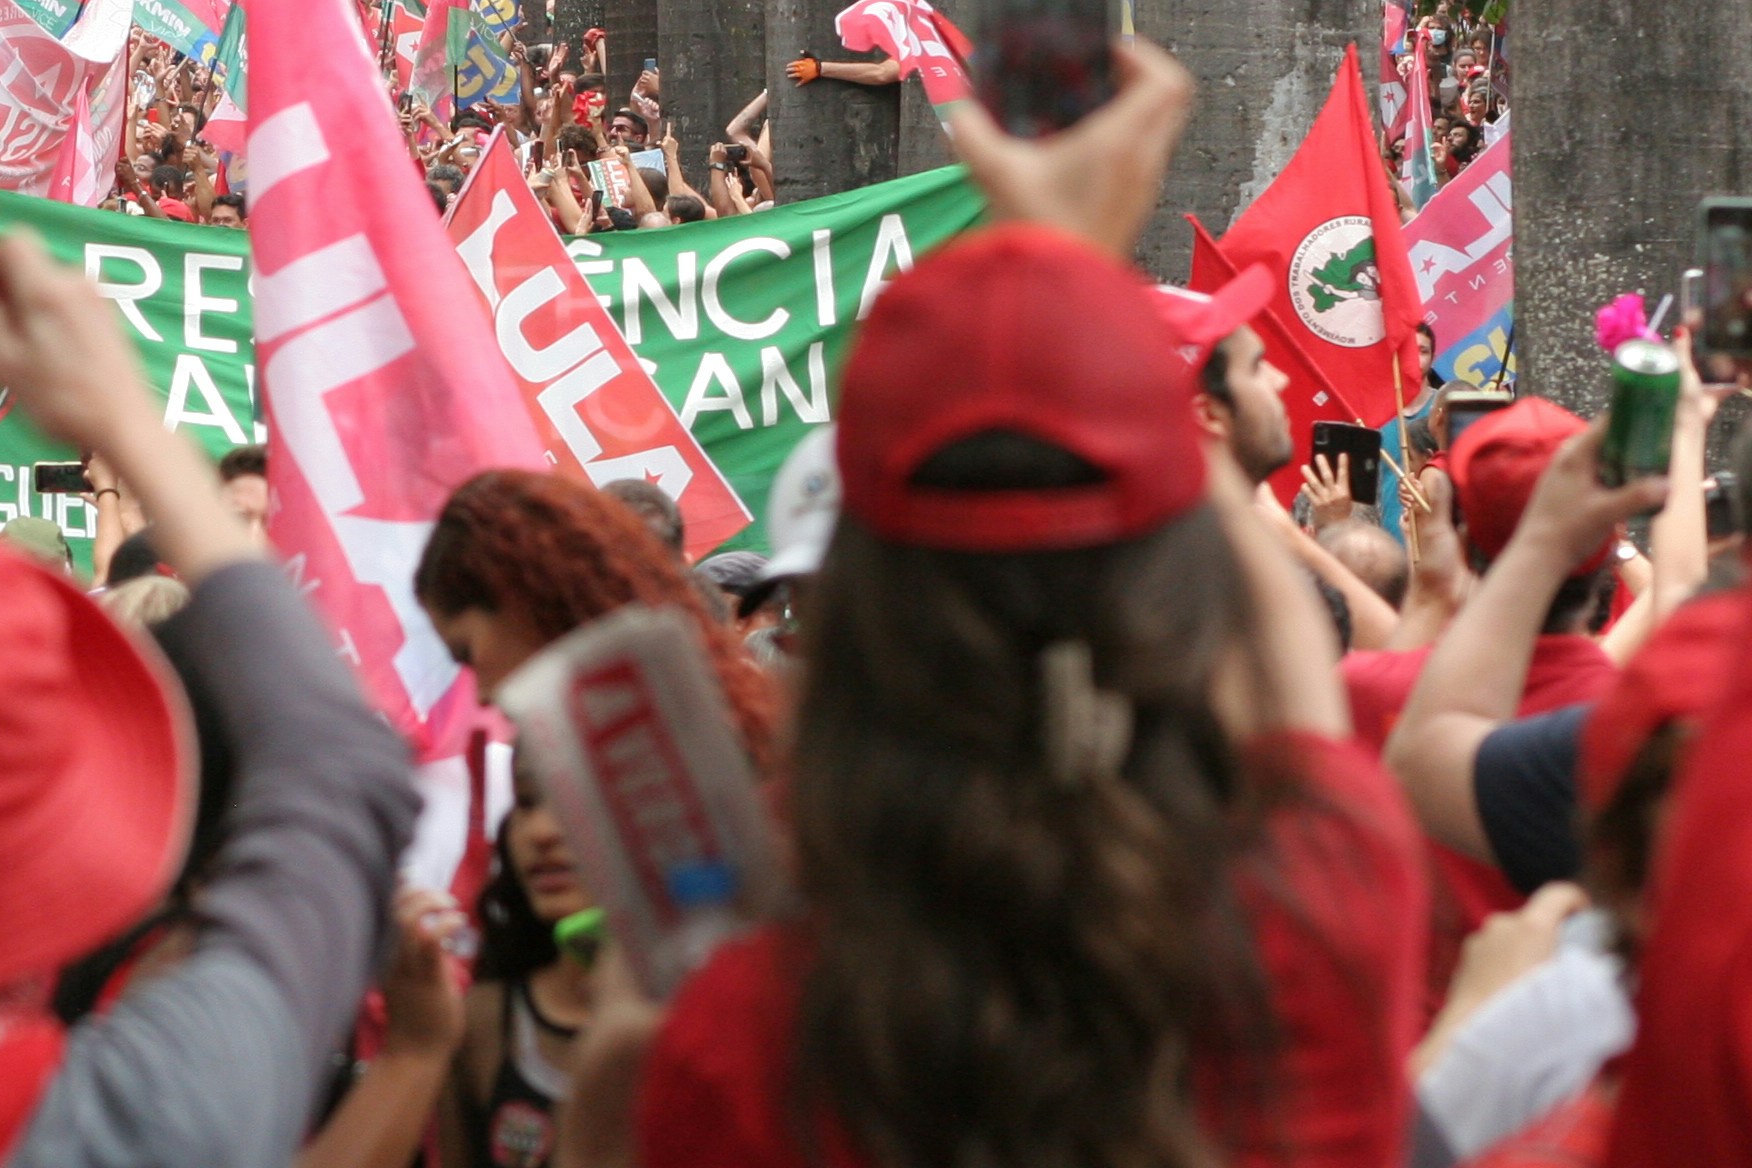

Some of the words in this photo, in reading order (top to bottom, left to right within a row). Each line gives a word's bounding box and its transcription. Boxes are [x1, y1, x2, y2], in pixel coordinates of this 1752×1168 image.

[1291, 220, 1342, 290] TRABALHADORES
[84, 242, 254, 353] RE
[1293, 291, 1305, 311] DOS
[1302, 311, 1356, 344] MOVIMENTO
[455, 187, 695, 504] LULA
